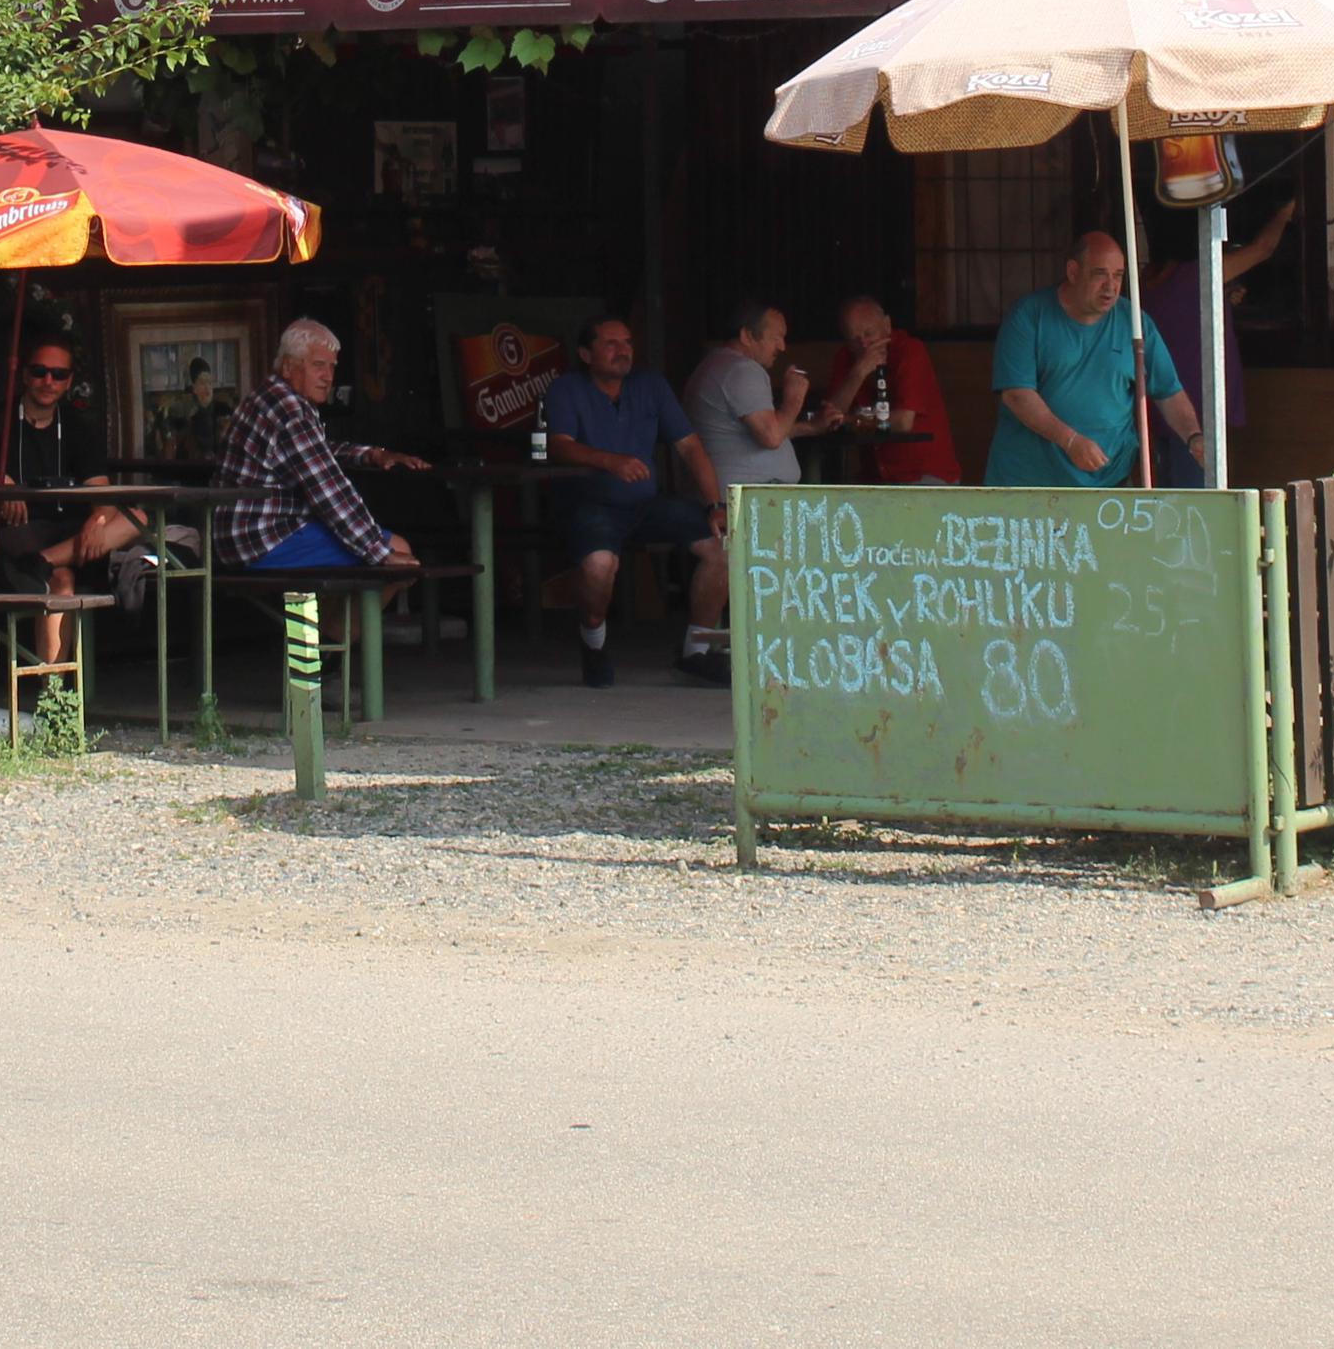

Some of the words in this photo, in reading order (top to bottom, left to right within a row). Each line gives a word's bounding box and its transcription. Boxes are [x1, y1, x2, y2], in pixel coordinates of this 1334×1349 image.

[1179, 9, 1305, 29] Kozel
[966, 69, 1053, 93] Kozel
[750, 495, 865, 568] LIMO
[941, 512, 1100, 575] BEZINKA
[1097, 498, 1160, 535] 0,5
[748, 564, 882, 625] PÁREK
[913, 568, 1075, 630] ROHLÍKU
[753, 627, 945, 701] KLOBÁSA
[979, 638, 1078, 726] 80
